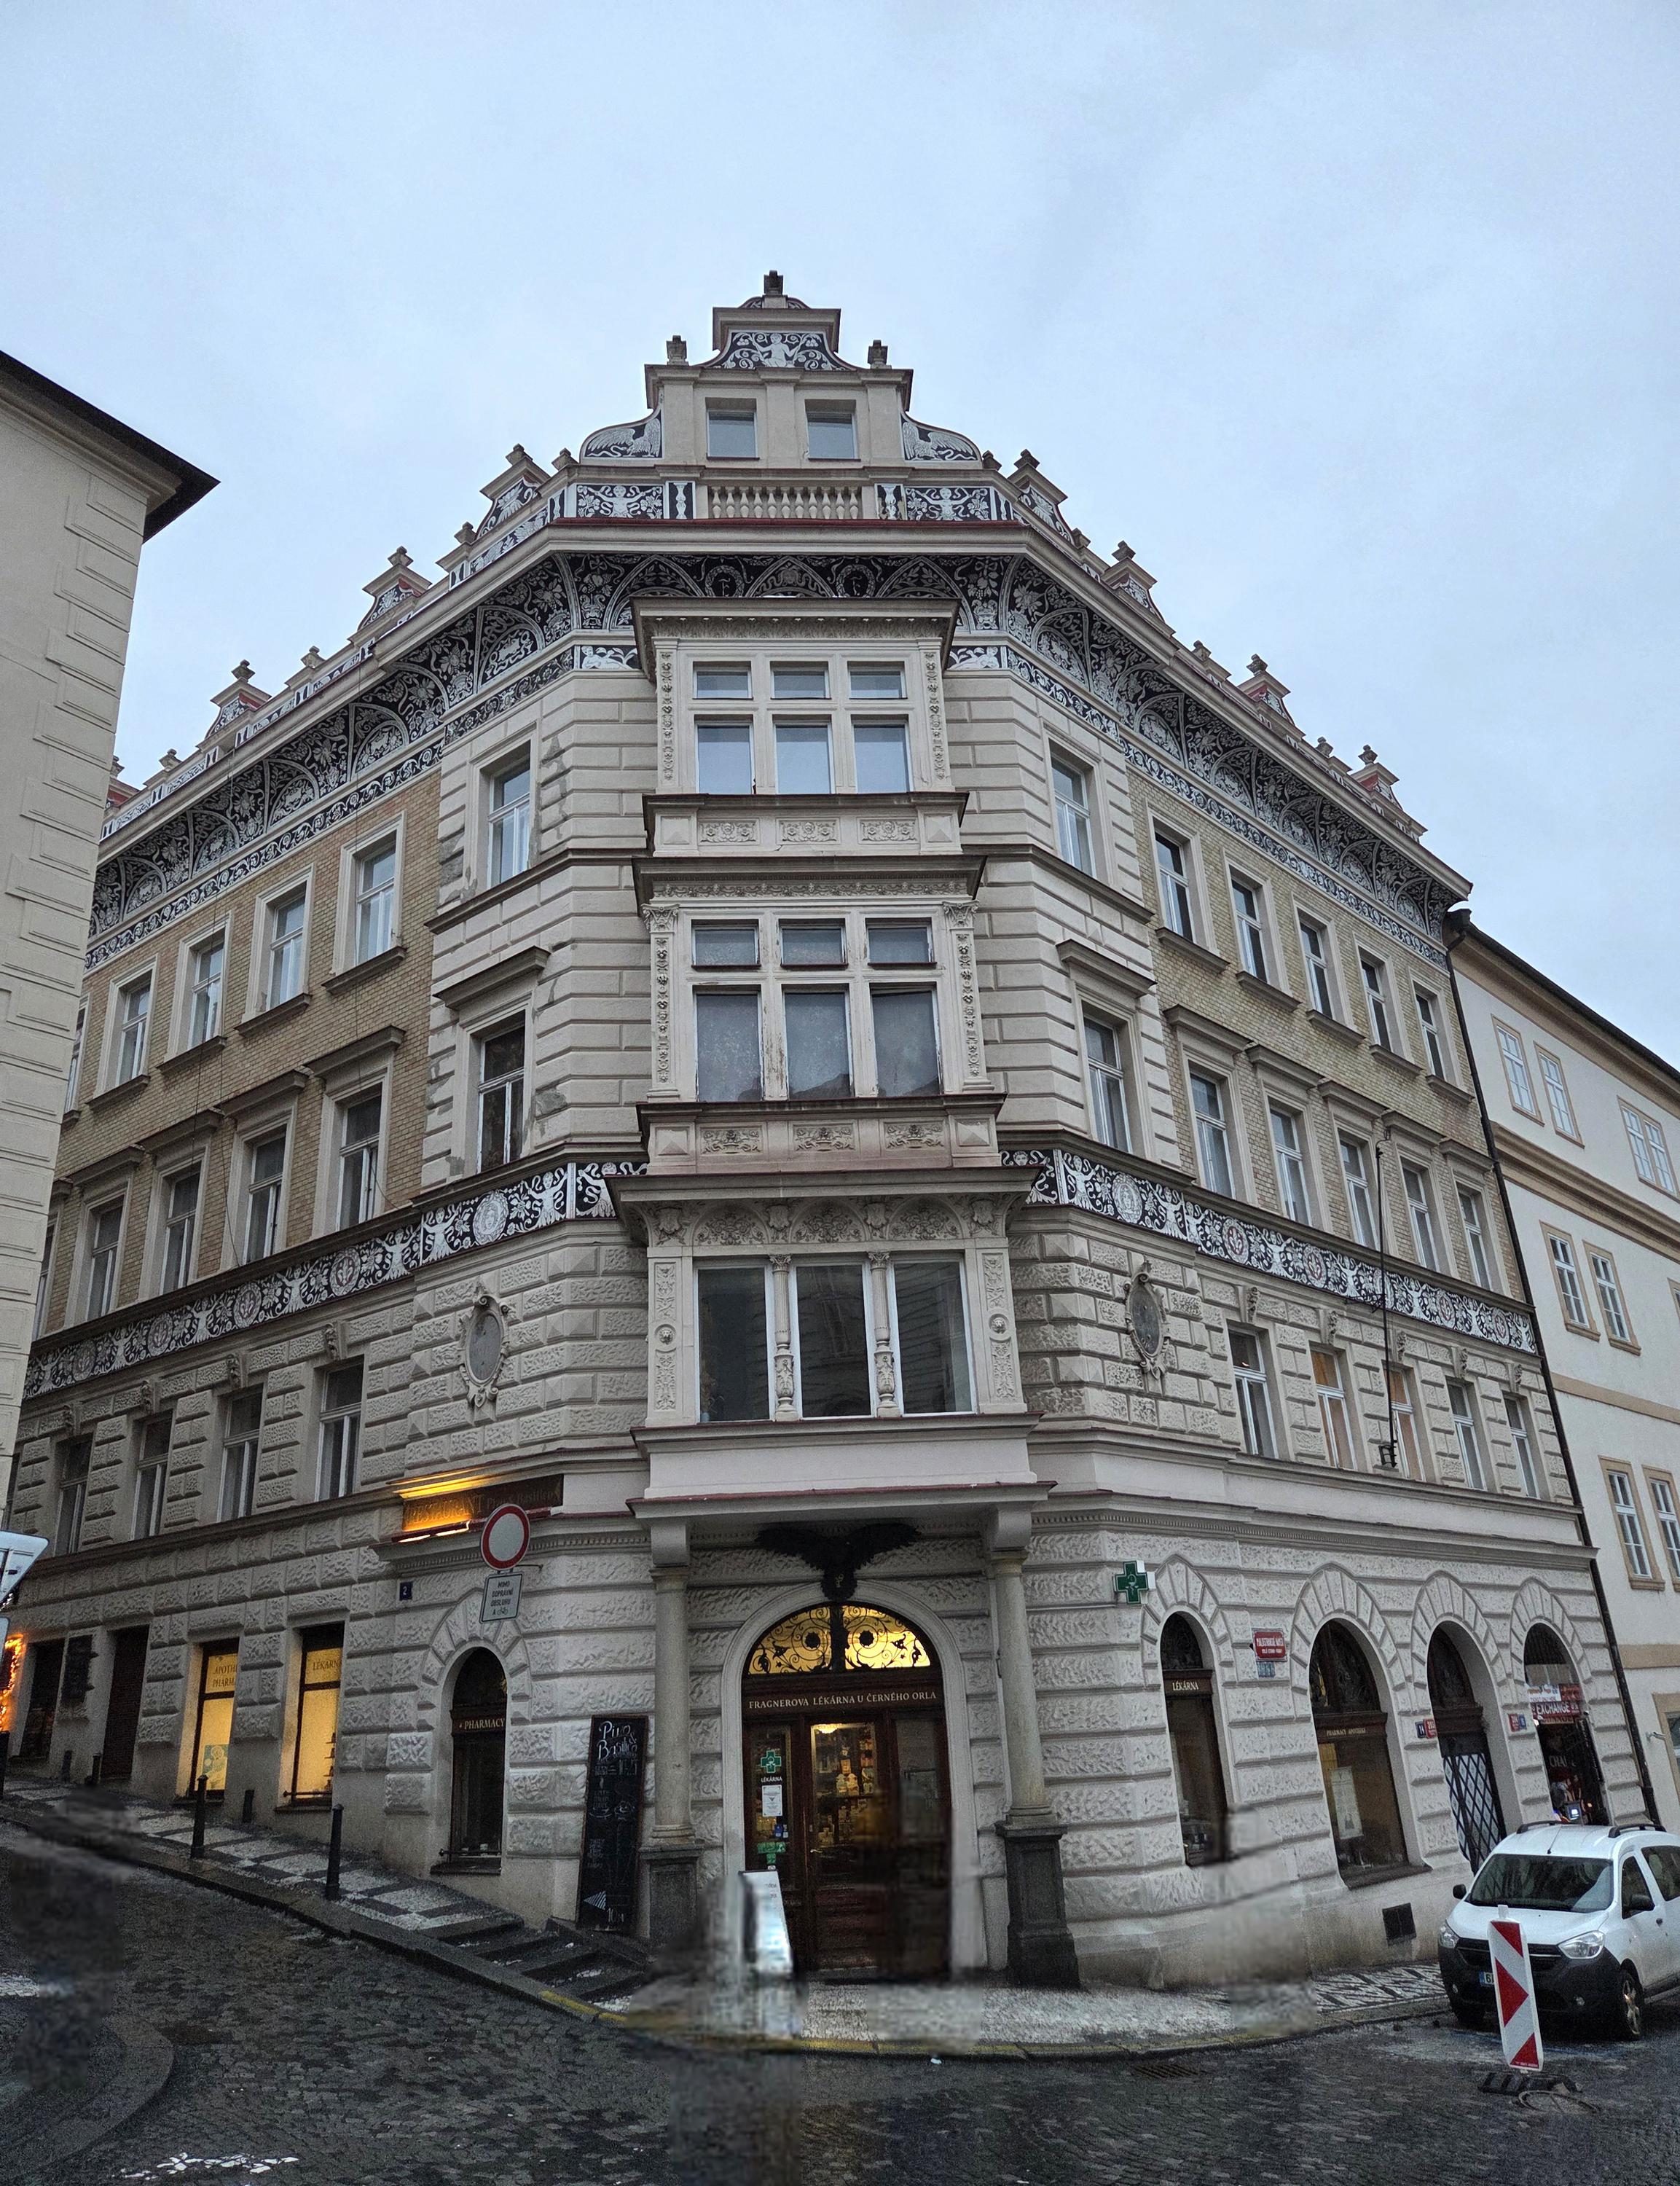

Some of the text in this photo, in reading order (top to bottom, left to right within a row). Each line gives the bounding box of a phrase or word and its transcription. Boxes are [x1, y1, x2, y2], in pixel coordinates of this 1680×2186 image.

[402, 1586, 407, 1595] 2
[212, 1678, 235, 1688] PHARM
[1172, 1680, 1198, 1691] LÉKÁRNA
[749, 1698, 809, 1709] FRAGNEROVA
[813, 1695, 855, 1705] LÉKÁRNA
[866, 1691, 910, 1702] ČERNÉHO
[912, 1691, 936, 1700] ORLA
[1536, 1702, 1571, 1715] EXCHANGE
[464, 1718, 505, 1729] PHARMACY
